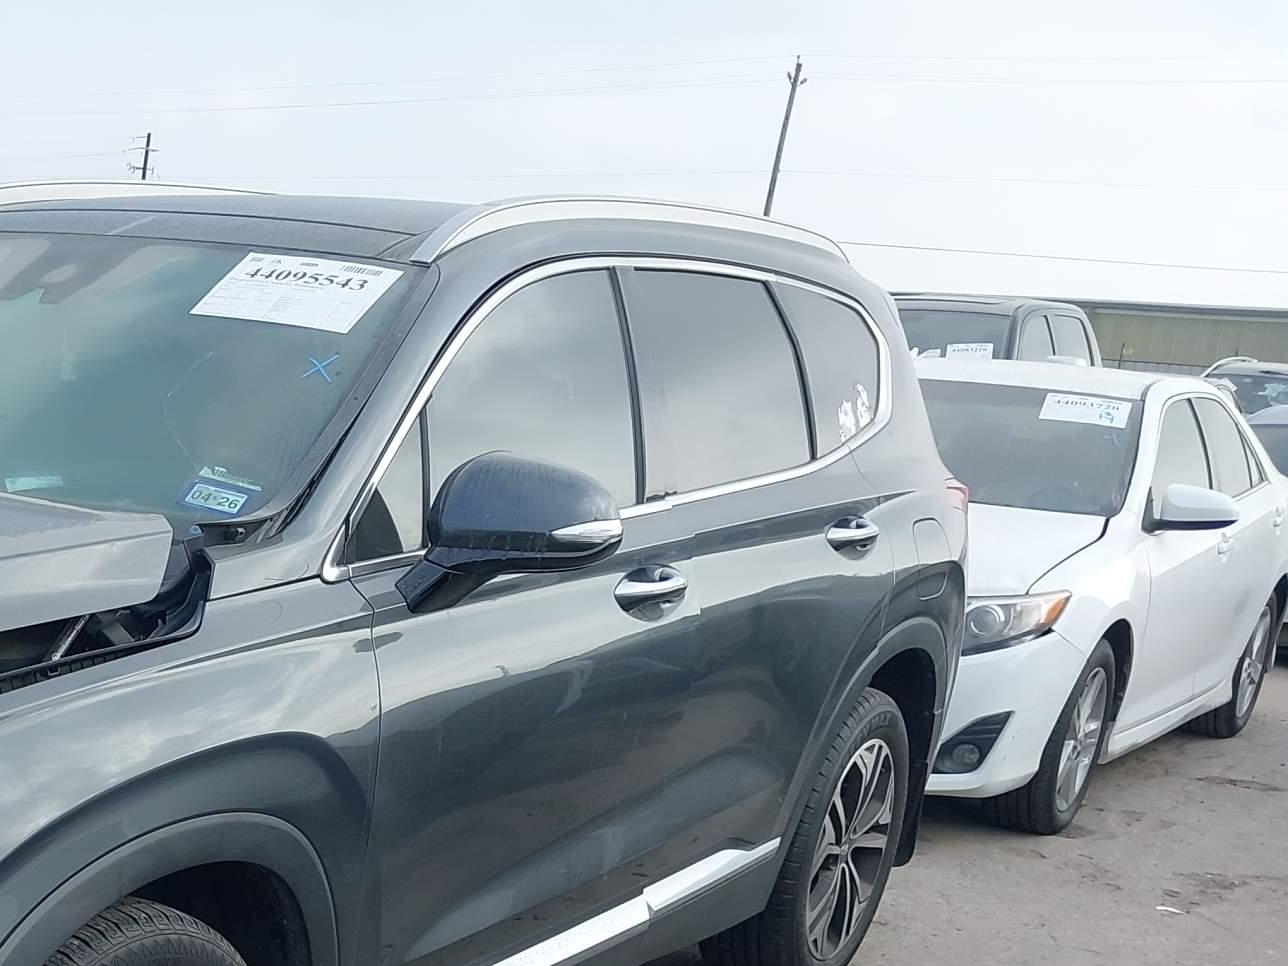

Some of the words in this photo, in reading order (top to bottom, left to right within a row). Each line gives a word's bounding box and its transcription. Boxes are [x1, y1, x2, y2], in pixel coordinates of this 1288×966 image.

[245, 266, 368, 291] 44095543
[191, 489, 212, 503] 04
[216, 496, 240, 509] 26
